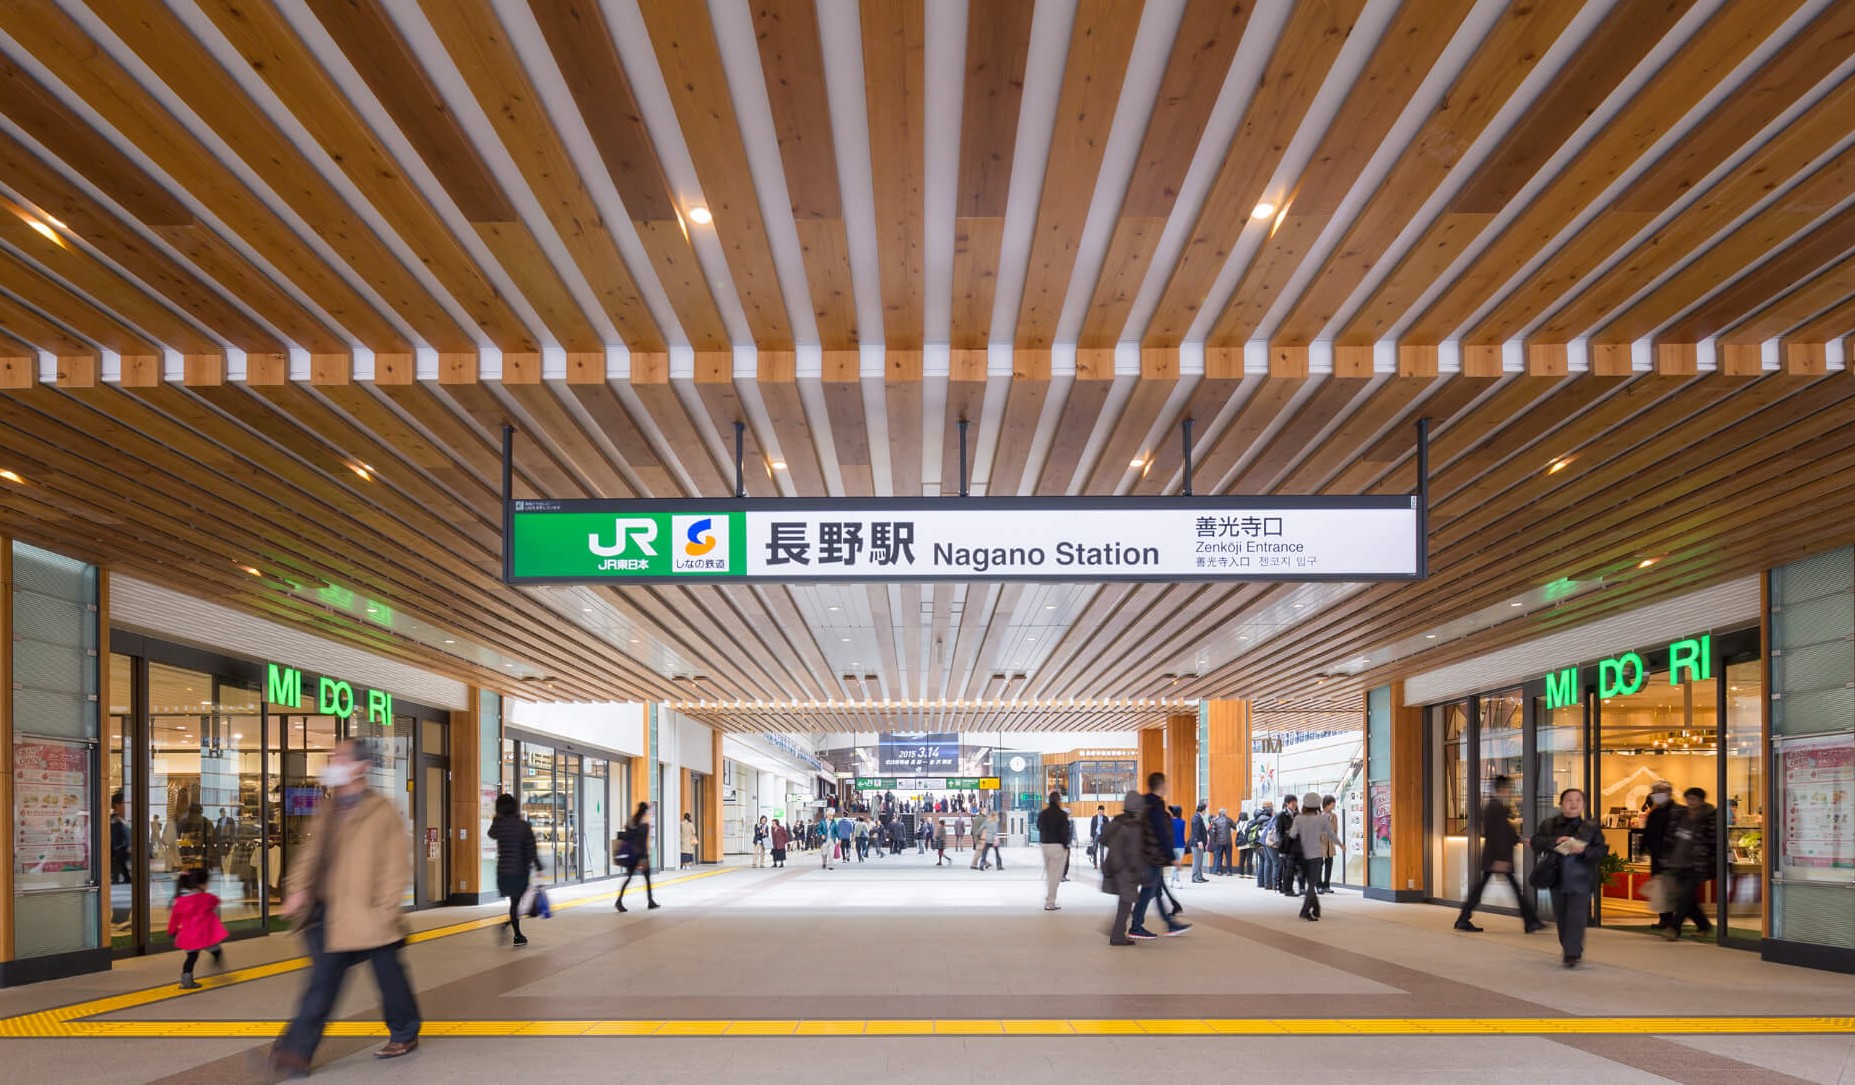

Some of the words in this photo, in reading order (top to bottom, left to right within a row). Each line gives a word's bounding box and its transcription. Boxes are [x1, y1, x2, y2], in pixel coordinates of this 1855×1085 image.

[1195, 515, 1282, 537] 善光寺口
[588, 518, 658, 557] JR
[765, 521, 916, 567] 長野駅
[1195, 541, 1242, 555] Zenkōji
[1247, 541, 1304, 553] Entrance
[933, 541, 1045, 571] Nagano
[1056, 541, 1159, 566] Station
[1195, 556, 1250, 568] 善光寺入口
[1259, 556, 1291, 567] 젠코지
[598, 559, 649, 570] JR東日本
[676, 559, 725, 569] しなの鉄道
[898, 750, 916, 758] 2015
[917, 746, 940, 758] 3.14
